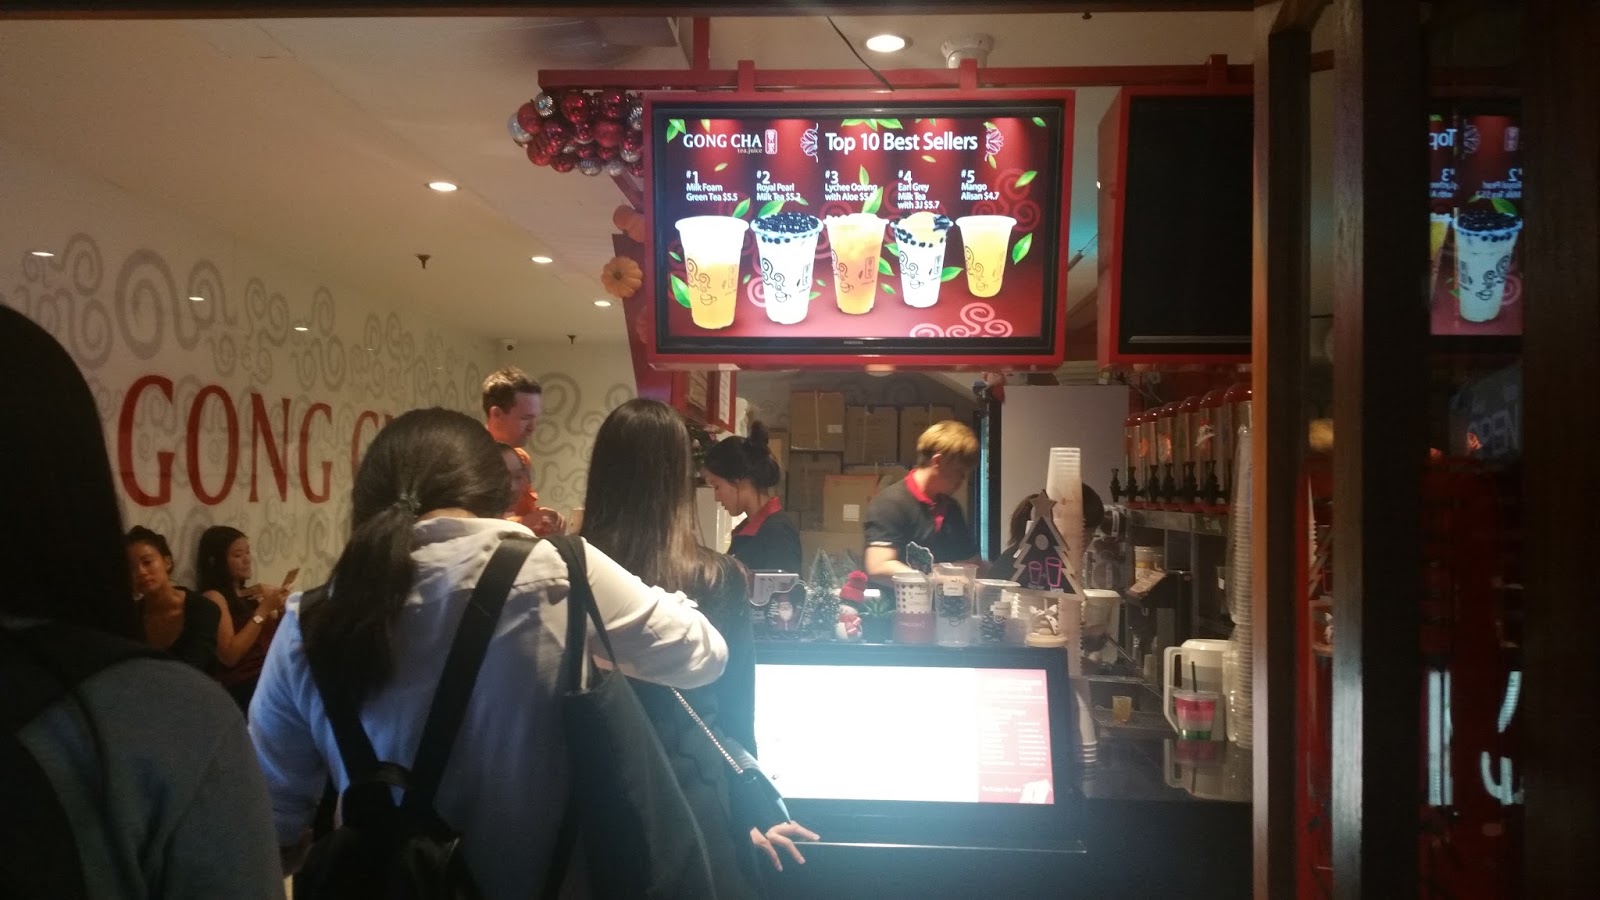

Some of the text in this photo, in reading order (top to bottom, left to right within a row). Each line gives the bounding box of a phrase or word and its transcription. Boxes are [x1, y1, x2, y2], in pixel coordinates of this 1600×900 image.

[683, 133, 762, 148] GONG CHA
[825, 131, 978, 154] Top 10 Best Sellers
[686, 170, 699, 183] #1
[756, 170, 770, 184] #2
[825, 170, 839, 184] #3
[898, 170, 912, 183] #4
[961, 169, 975, 183] #5
[686, 183, 723, 192] Milk Foam
[756, 183, 795, 193] Royal Pearl
[825, 183, 850, 192] Lychee
[898, 183, 930, 193] Earl Grey
[961, 183, 988, 192] Mango
[686, 192, 738, 202] Green Tea $5.5
[756, 192, 772, 201] Milk
[773, 192, 785, 201] Tea
[825, 192, 841, 201] with
[842, 192, 859, 201] Aloe
[898, 192, 927, 201] Milk Tea
[960, 192, 999, 201] Alisan $4.7
[897, 200, 914, 209] with
[923, 200, 940, 210] $5.7
[117, 374, 394, 507] GONG C
